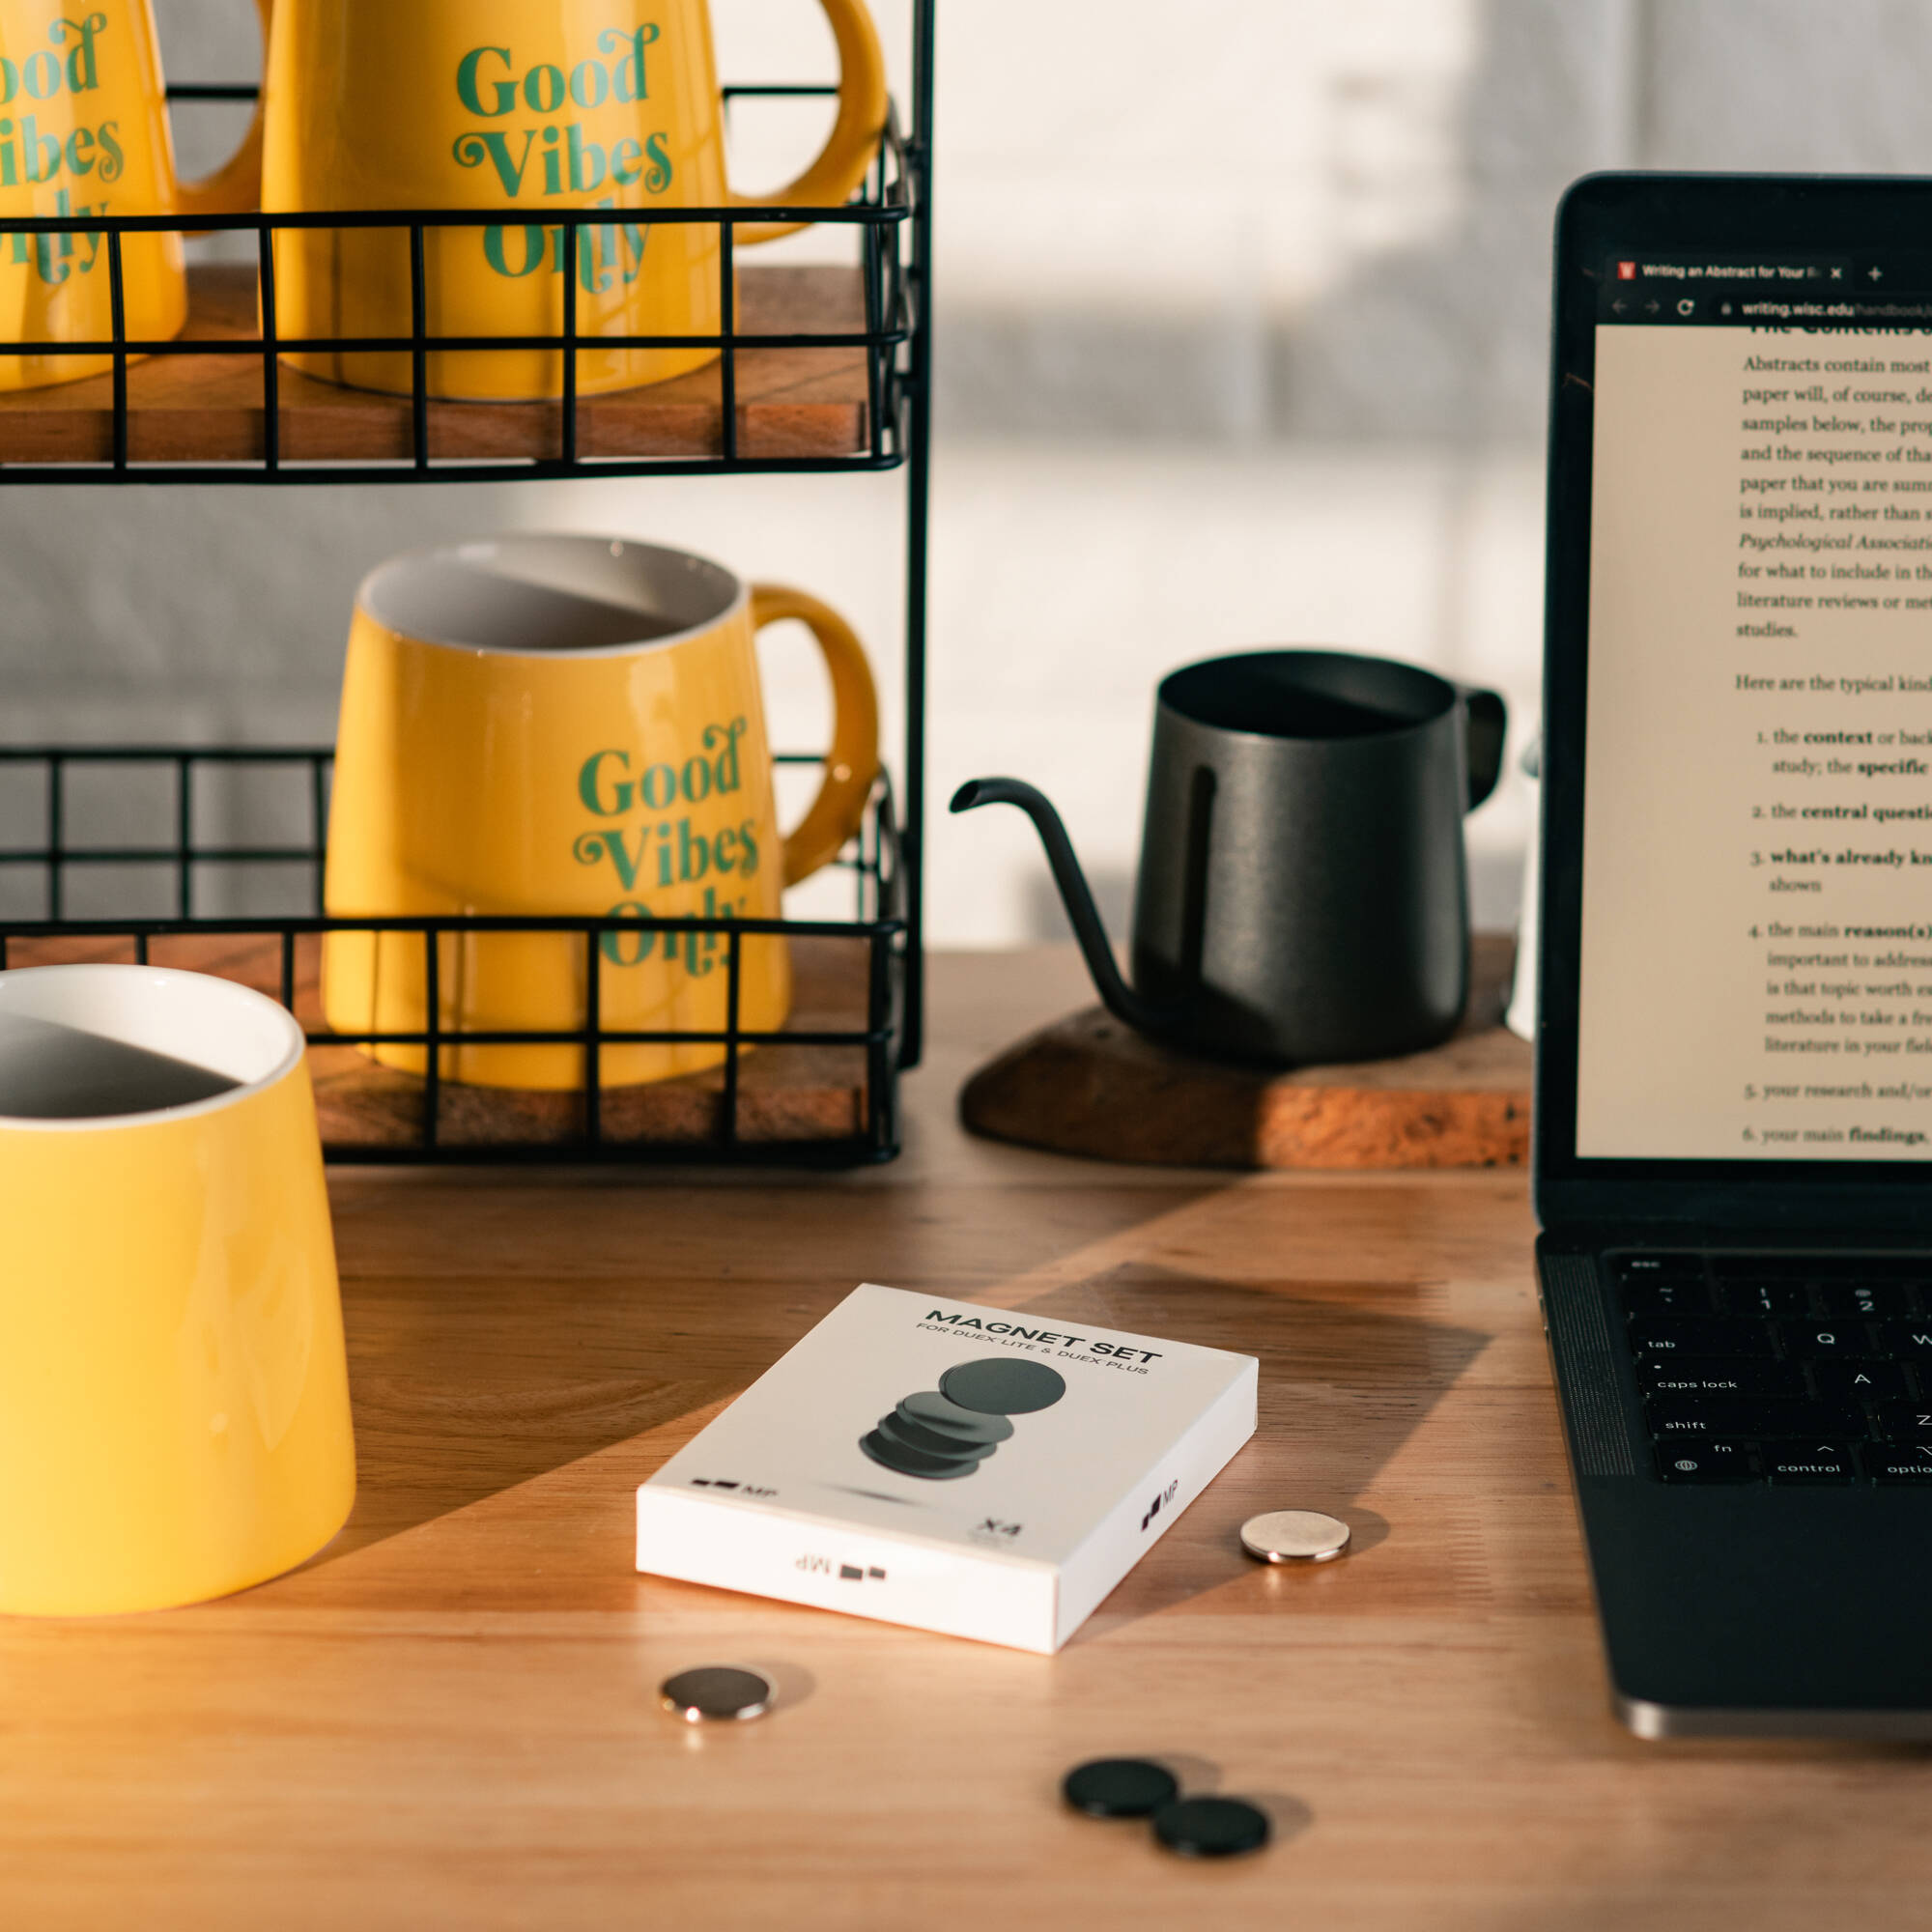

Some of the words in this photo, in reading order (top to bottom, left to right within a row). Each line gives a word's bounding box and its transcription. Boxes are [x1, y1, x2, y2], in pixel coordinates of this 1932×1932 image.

[456, 23, 660, 117] Good
[452, 124, 672, 197] Vibes
[0, 188, 108, 284] nly
[483, 198, 650, 295] Only
[1642, 264, 1686, 279] Writing
[1688, 267, 1702, 277] an
[1705, 265, 1755, 278] Abstract
[1758, 265, 1776, 277] for
[1777, 266, 1804, 278] Your
[1744, 356, 1820, 372] Abstracts
[1825, 357, 1884, 372] contain
[1890, 359, 1930, 374] most
[1743, 388, 1789, 404] paper
[1794, 386, 1829, 404] will,
[1833, 386, 1849, 402] of
[1853, 390, 1911, 405] course,
[1742, 416, 1807, 436] samples
[1813, 415, 1865, 433] below,
[1870, 416, 1895, 432] the
[1741, 445, 1771, 460] and
[1777, 445, 1802, 460] the
[1806, 449, 1881, 465] sequence
[1886, 446, 1903, 461] of
[1740, 478, 1785, 494] paper
[1792, 475, 1823, 491] that
[1829, 480, 1857, 495] you
[1862, 480, 1888, 492] are
[1740, 503, 1752, 519] is
[1758, 503, 1823, 522] implied,
[1830, 504, 1877, 520] rather
[1884, 504, 1919, 520] than
[1740, 533, 1852, 552] Psychological
[1739, 563, 1760, 578] for
[1767, 563, 1804, 579] what
[1810, 566, 1826, 579] to
[1832, 563, 1889, 580] include
[1896, 564, 1910, 580] in
[1738, 592, 1812, 609] literature
[1818, 593, 1878, 609] reviews
[1883, 598, 1899, 609] or
[1737, 621, 1798, 638] studies.
[1736, 675, 1775, 690] Here
[1779, 679, 1804, 690] are
[1809, 675, 1834, 690] the
[1840, 676, 1893, 695] typical
[1757, 732, 1768, 744] 1.
[1774, 728, 1799, 744] the
[1804, 731, 1872, 745] context
[1877, 734, 1894, 745] or
[578, 715, 747, 817] Good
[1773, 757, 1822, 777] study;
[1827, 758, 1852, 774] the
[1858, 758, 1928, 777] specific
[1752, 807, 1767, 818] 2.
[1772, 803, 1796, 818] the
[1802, 803, 1867, 818] central
[573, 818, 758, 892] Vibes
[1750, 852, 1764, 867] 3.
[1770, 848, 1831, 864] what's
[1835, 849, 1904, 869] already
[1770, 876, 1822, 893] shown
[1748, 924, 1763, 938] 4.
[1768, 922, 1793, 937] the
[1798, 923, 1838, 937] main
[1767, 951, 1848, 971] important
[1854, 953, 1869, 966] to
[1767, 980, 1778, 995] is
[1784, 980, 1815, 996] that
[1821, 980, 1859, 1000] topic
[1865, 981, 1913, 996] worth
[1766, 1009, 1834, 1024] methods
[1840, 1011, 1856, 1025] to
[1861, 1009, 1893, 1025] take
[1899, 1014, 1907, 1025] a
[1765, 1037, 1838, 1053] literature
[1844, 1037, 1860, 1053] in
[1864, 1041, 1900, 1057] your
[1745, 1084, 1758, 1099] 5.
[1764, 1085, 1800, 1100] your
[1805, 1082, 1872, 1097] research
[1743, 1126, 1756, 1142] 6.
[1762, 1130, 1798, 1145] your
[1804, 1127, 1843, 1142] main
[1860, 1301, 1875, 1311] 2
[924, 1310, 1086, 1349] MAGNET
[1090, 1342, 1163, 1364] SET
[1817, 1333, 1835, 1344] Q
[917, 1322, 949, 1334] FOR
[952, 1329, 997, 1343] DUEX
[1001, 1339, 1036, 1350] LITE
[1057, 1350, 1102, 1365] DUEX
[1106, 1360, 1150, 1376] PLUS
[1854, 1374, 1871, 1383] A
[1665, 1421, 1707, 1430] shift
[1917, 1415, 1932, 1426] Z
[1777, 1464, 1840, 1473] control
[741, 1486, 778, 1499] MP
[1161, 1478, 1179, 1509] MP
